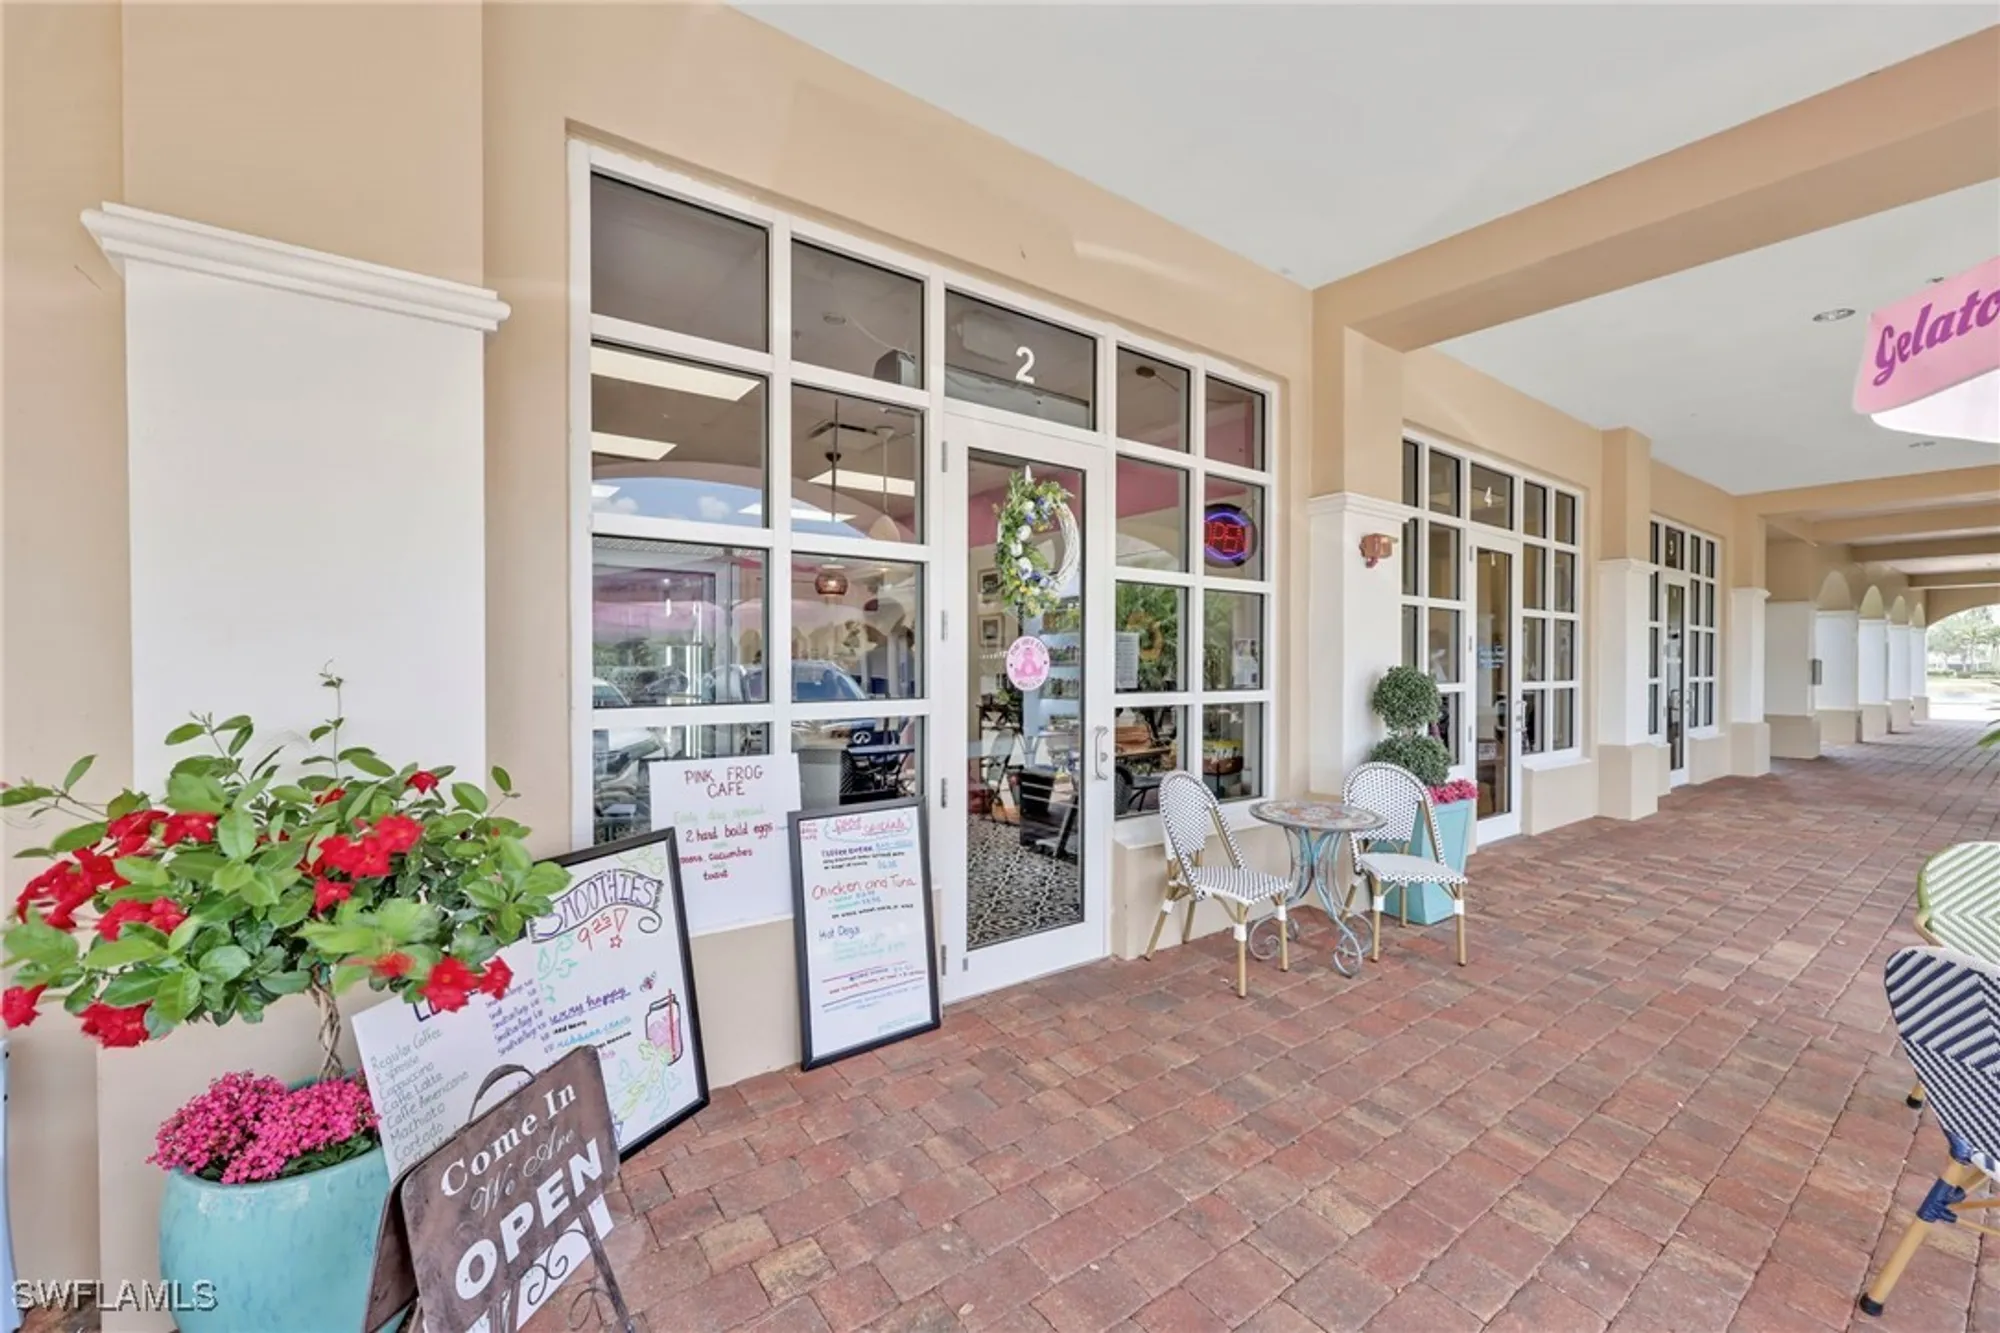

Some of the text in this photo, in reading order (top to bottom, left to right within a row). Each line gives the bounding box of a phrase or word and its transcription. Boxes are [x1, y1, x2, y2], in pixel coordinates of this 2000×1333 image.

[1872, 289, 2000, 386] Gelato
[1015, 346, 1035, 384] 2
[1484, 486, 1492, 508] 4
[684, 765, 764, 785] PINK FROG
[707, 781, 745, 798] CAFE
[685, 829, 694, 842] 2
[412, 1028, 443, 1051] Coffee
[440, 1083, 577, 1197] Come In
[470, 1126, 576, 1218] We Are
[455, 1138, 603, 1301] OPEN
